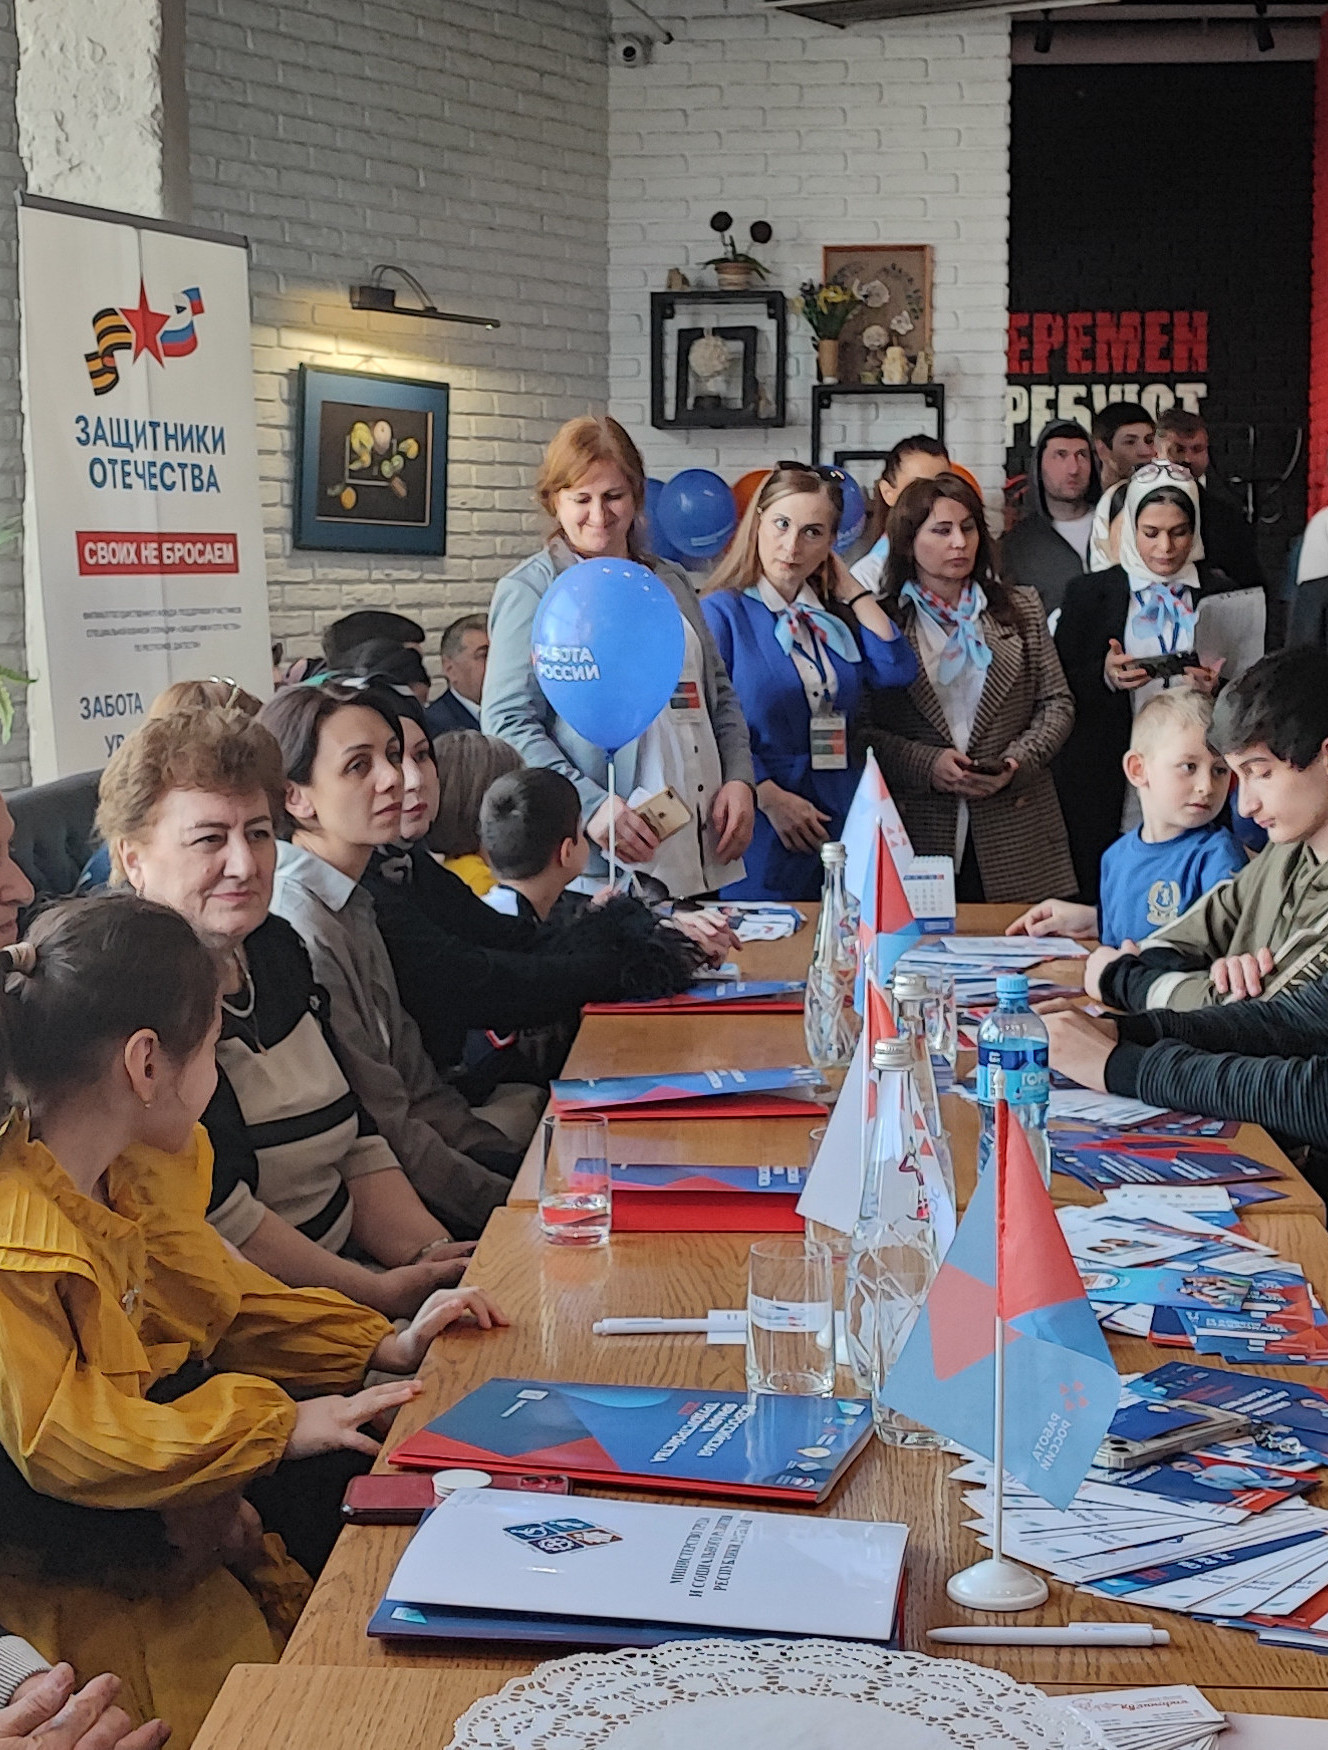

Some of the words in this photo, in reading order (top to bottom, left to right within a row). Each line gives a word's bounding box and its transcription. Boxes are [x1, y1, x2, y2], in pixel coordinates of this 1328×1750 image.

[1008, 310, 1208, 374] ЕРЕМЕН
[1006, 382, 1208, 448] РЕБУЮТ
[75, 415, 226, 455] ЗАЩИТНИКИ
[89, 457, 221, 493] ОТЕЧЕСТВА
[84, 541, 139, 565] СВОИХ
[140, 542, 160, 565] НЕ
[161, 542, 235, 565] БРОСАЕМ
[536, 661, 600, 681] РОССИИ
[79, 692, 144, 720] ЗАБОТА
[670, 1531, 703, 1584] МИНИСТЕРСТВО
[713, 1544, 741, 1591] РЕСПУБЛИКИ
[689, 1590, 703, 1598] И
